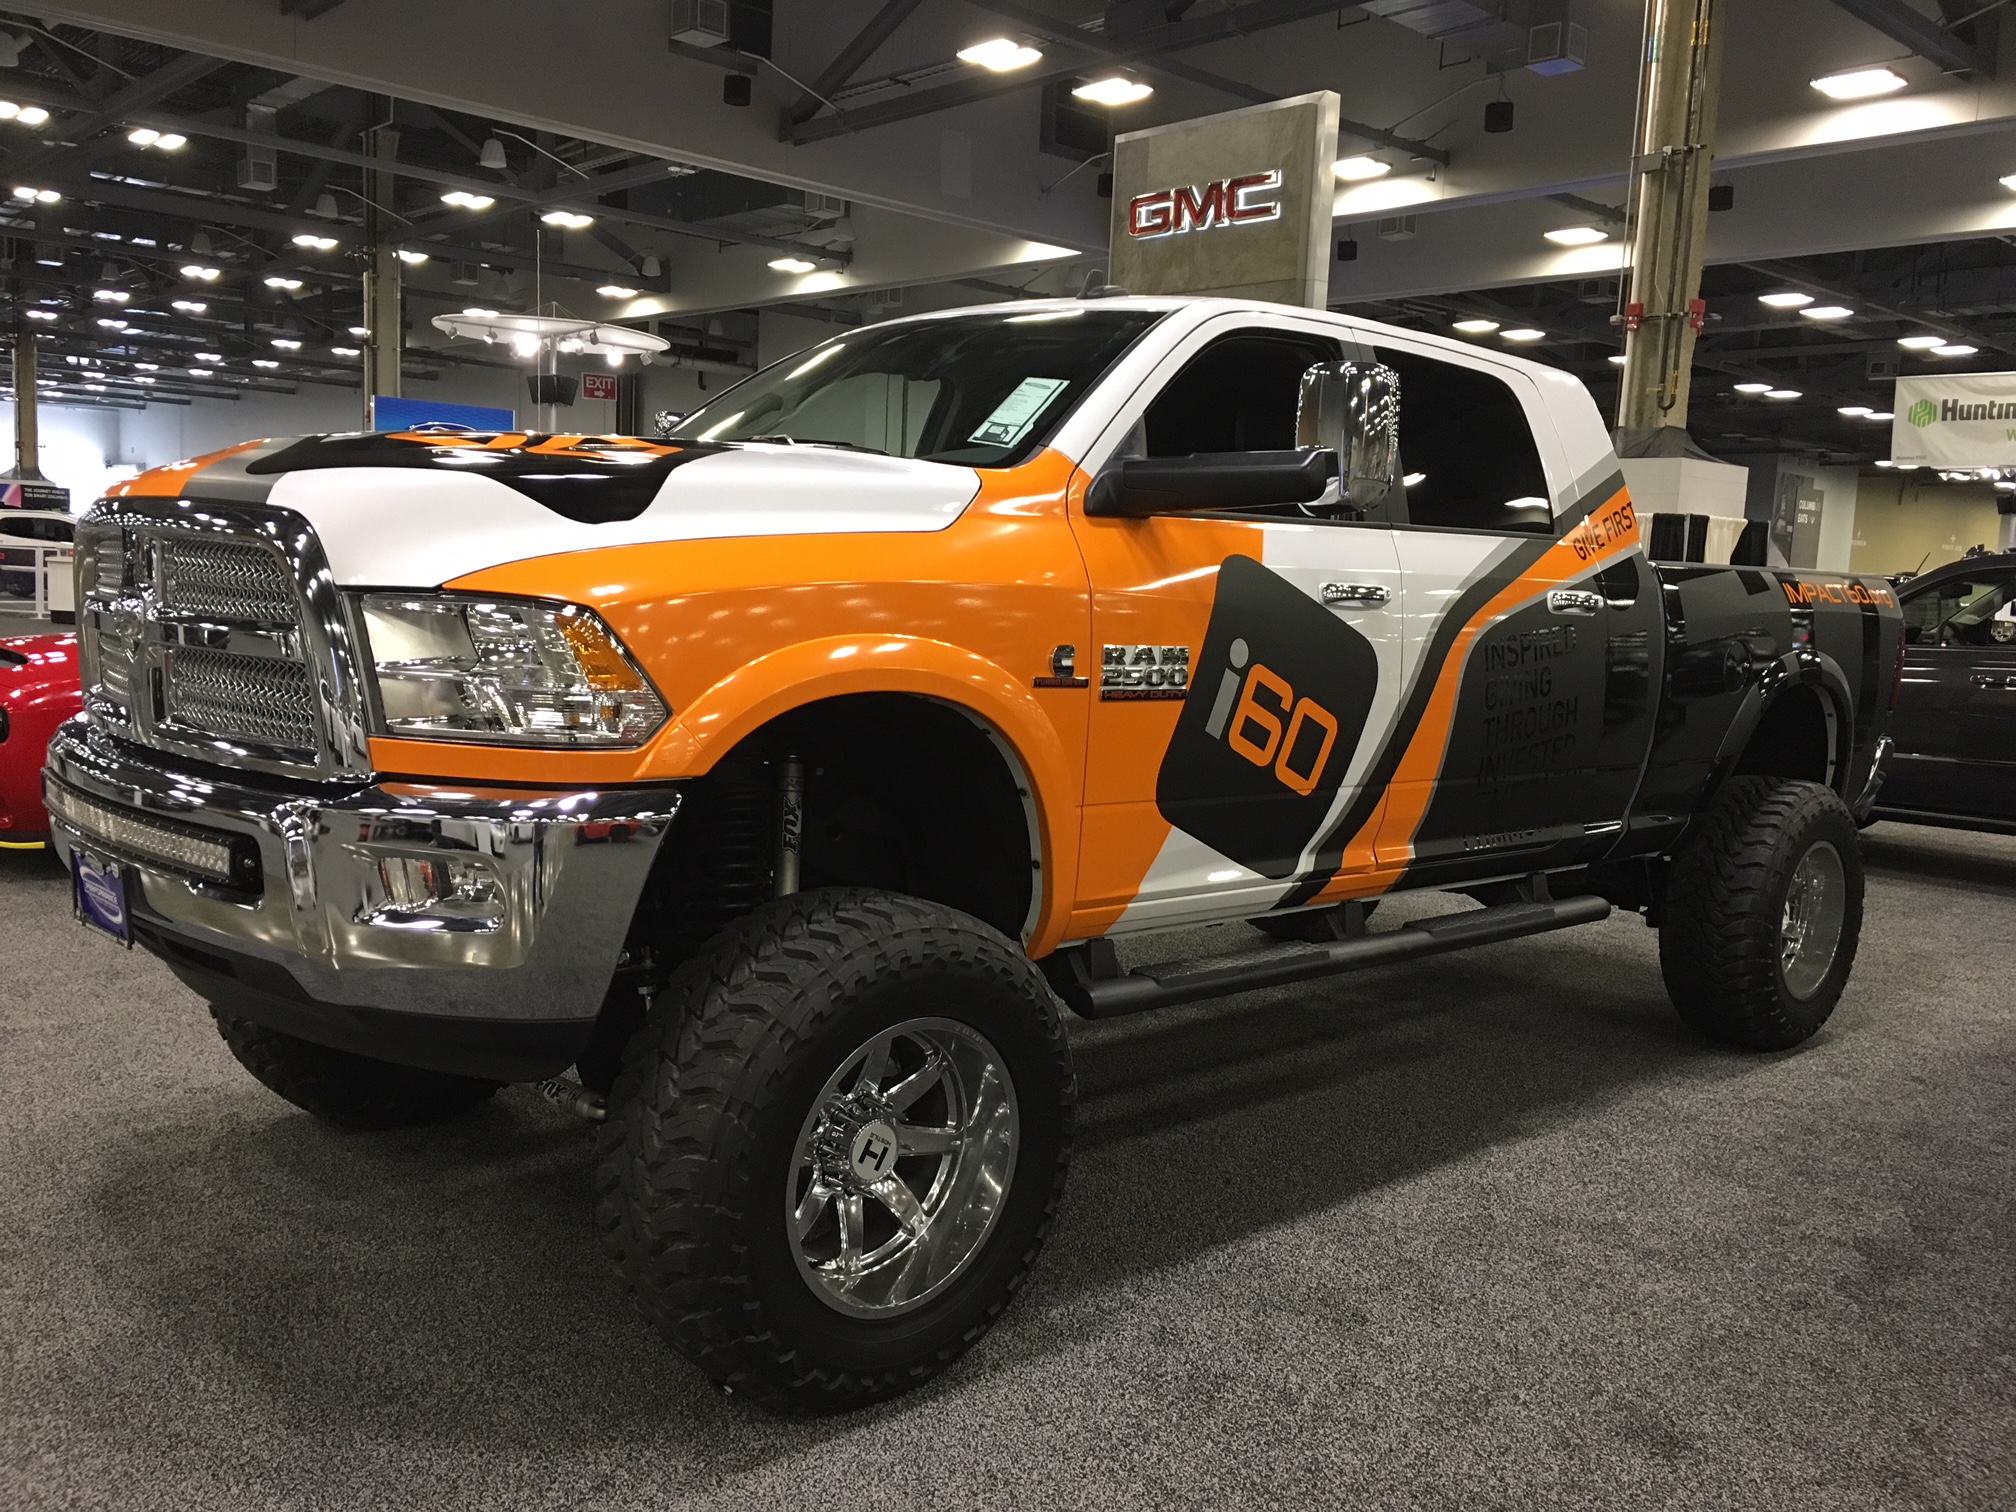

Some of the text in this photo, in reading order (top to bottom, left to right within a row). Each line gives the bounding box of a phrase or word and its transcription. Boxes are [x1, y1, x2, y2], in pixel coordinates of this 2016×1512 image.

[1129, 169, 1281, 240] GMC
[585, 376, 613, 389] EXIT
[1941, 398, 2016, 421] Huntin
[1573, 501, 1637, 561] GIVE FIRST
[1797, 513, 1808, 524] EATS
[1782, 582, 1894, 609] IMPACT60.org
[1102, 644, 1189, 665] RAM
[1484, 623, 1577, 672] INSPIRED
[1101, 666, 1188, 686] 2500
[1484, 666, 1552, 711] GIVING
[1104, 690, 1185, 699] HEAVY DUTY
[1204, 637, 1338, 797] i60
[1482, 696, 1578, 751] THROUGH
[782, 796, 801, 854] FOX
[869, 1132, 892, 1147] HOSTILE
